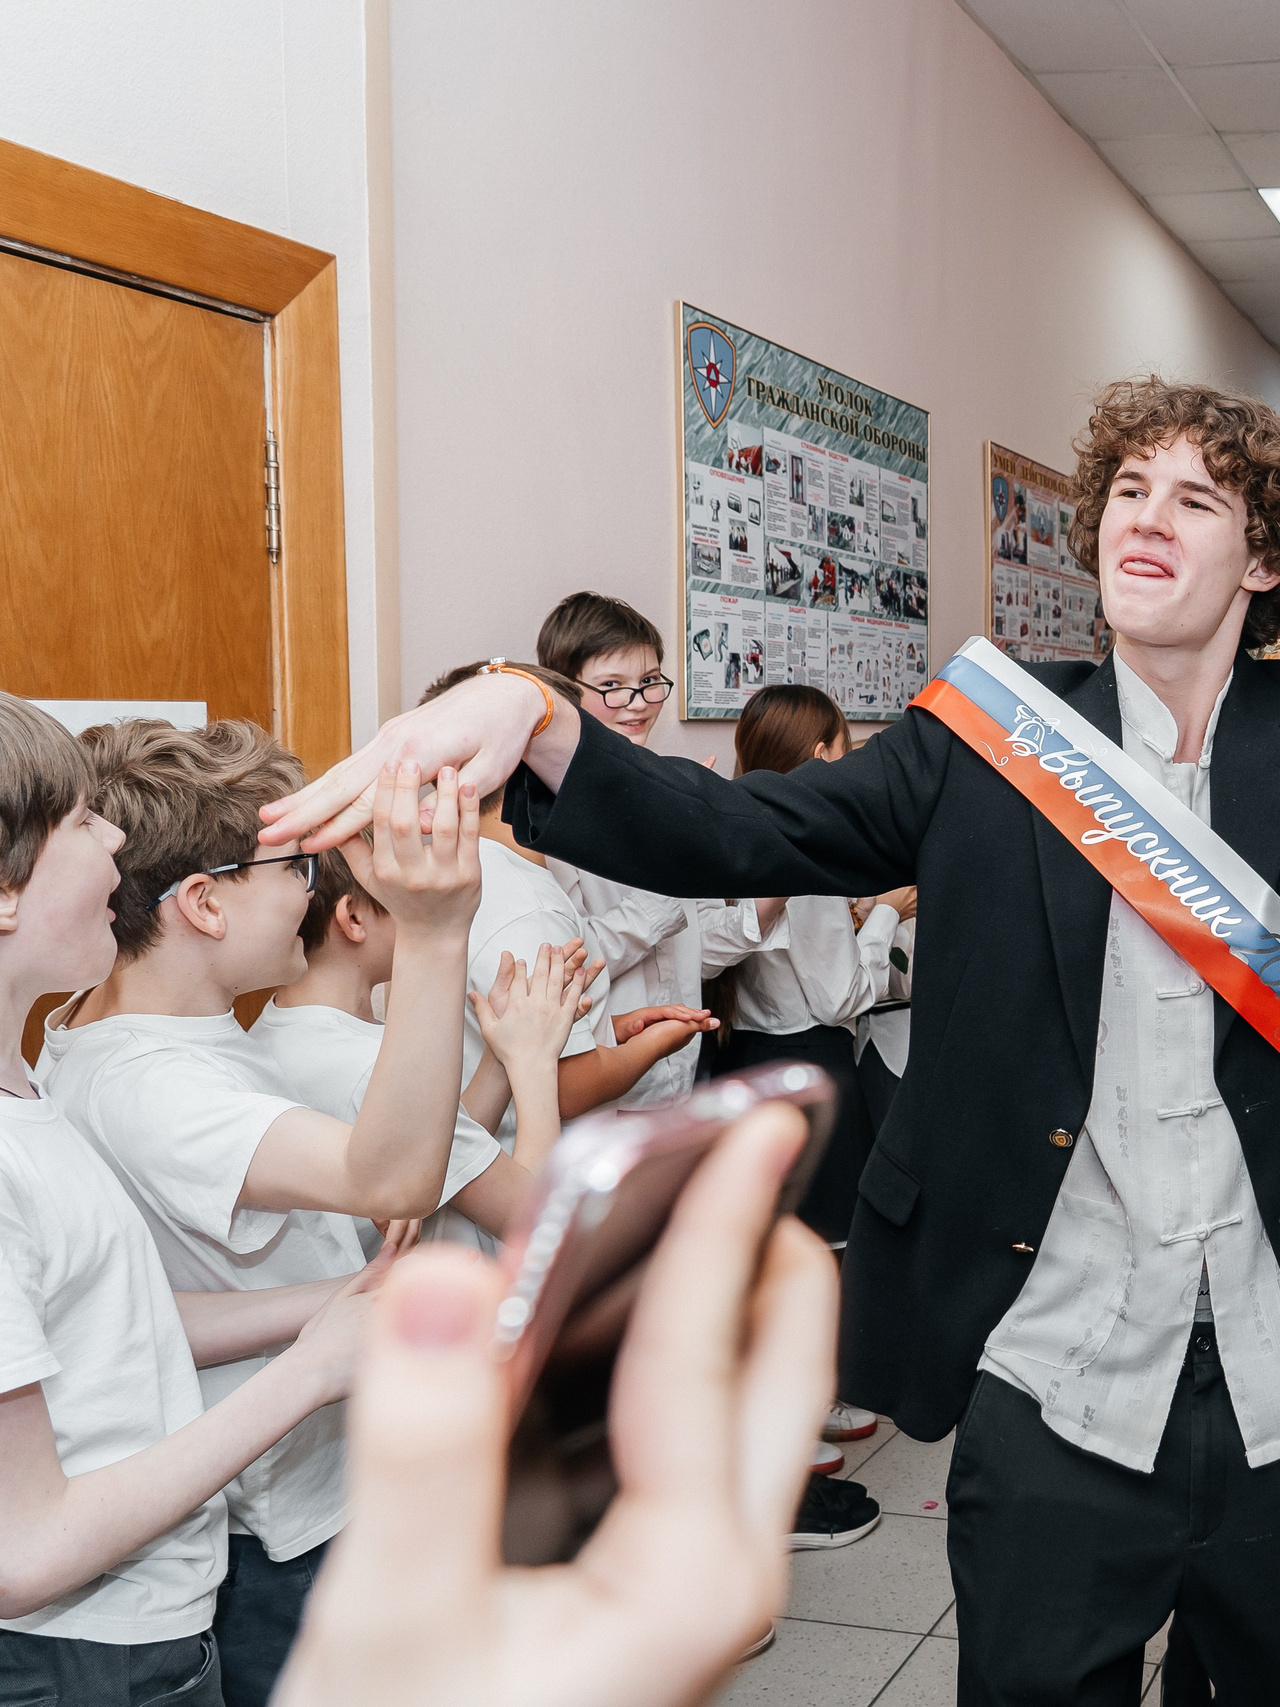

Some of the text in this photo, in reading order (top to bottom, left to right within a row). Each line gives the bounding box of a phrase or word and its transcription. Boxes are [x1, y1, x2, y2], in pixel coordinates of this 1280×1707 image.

[746, 375, 926, 464] ГРАЖДАНСКОЙ ОБОРОНЫ
[817, 377, 873, 418] УГОЛОК
